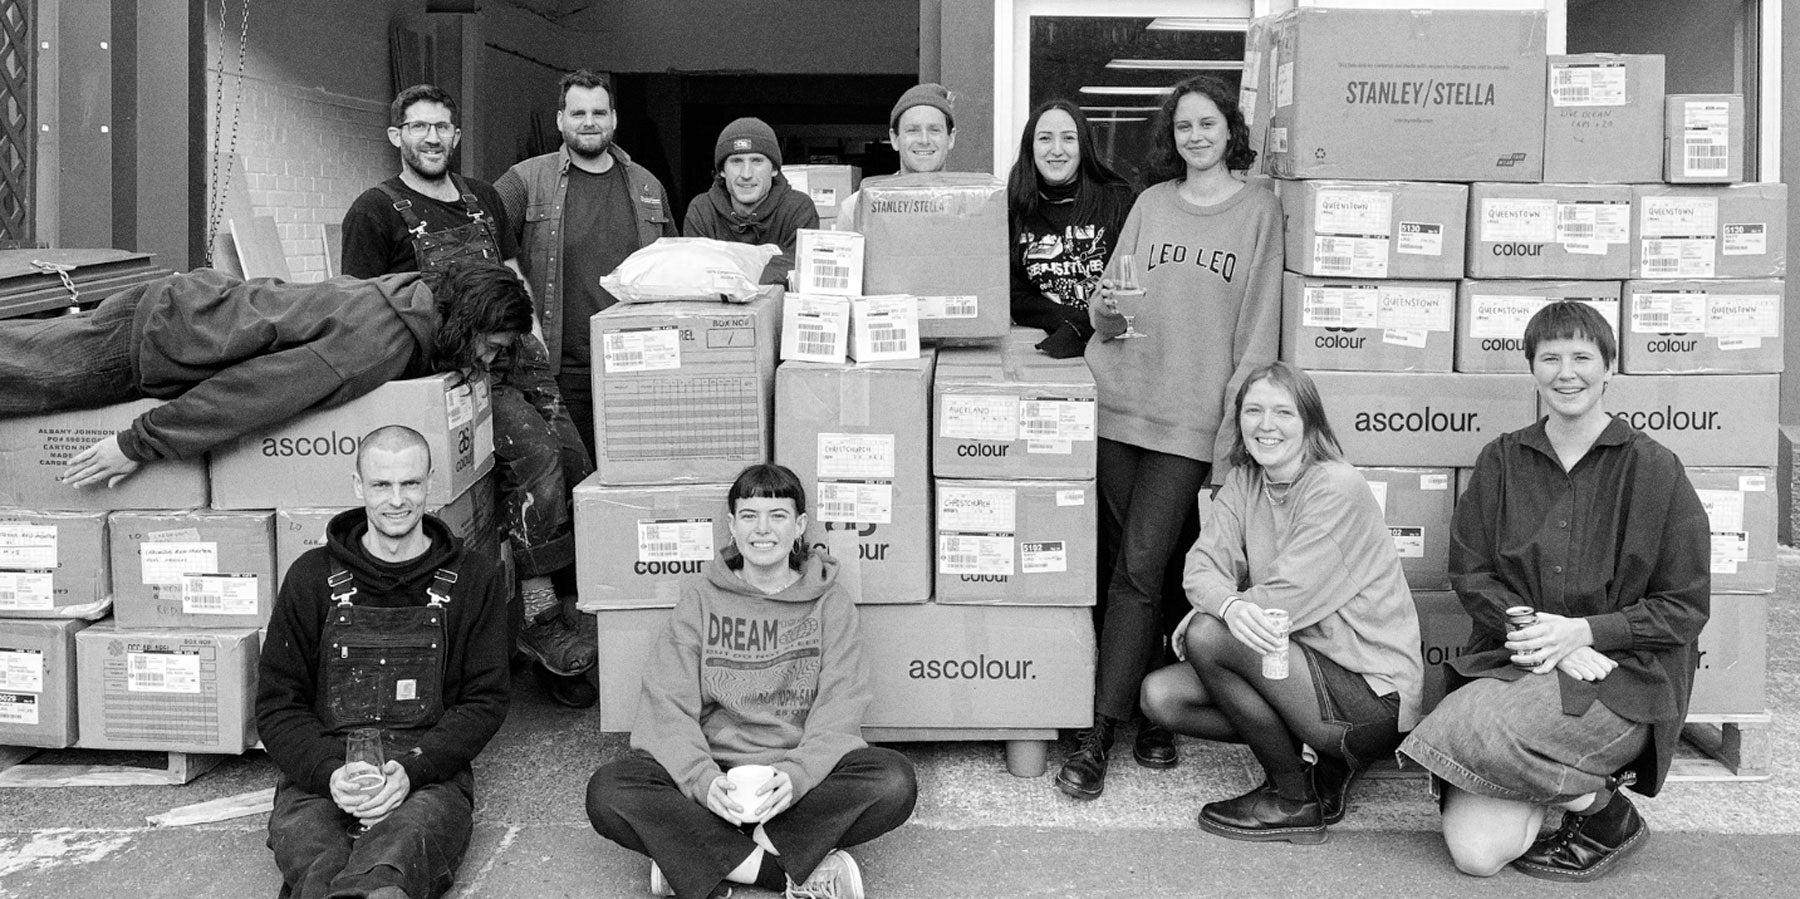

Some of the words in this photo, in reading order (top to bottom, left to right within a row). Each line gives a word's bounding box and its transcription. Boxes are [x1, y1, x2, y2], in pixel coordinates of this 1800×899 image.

[1346, 79, 1495, 108] STANLEY/STELLA
[871, 200, 945, 214] STANLEY/STELLA
[1488, 209, 1541, 218] QUEENSTOWN
[1648, 207, 1695, 217] QUEENSTOWN
[1492, 242, 1545, 256] colour
[1147, 243, 1187, 272] LEO
[1382, 298, 1439, 308] QUEENSTOWN
[1478, 306, 1530, 315] QUEENSTOWN
[1711, 306, 1757, 315] QUEENSTOWN
[1314, 335, 1367, 349] colour
[1481, 338, 1525, 351] colou
[1647, 339, 1698, 353] colour
[1355, 406, 1480, 432] ascolour.
[1604, 405, 1721, 431] colour.
[262, 430, 361, 457] ascolo
[957, 443, 1010, 457] colour
[707, 612, 778, 651] DREAM
[909, 654, 1037, 679] ascolour.
